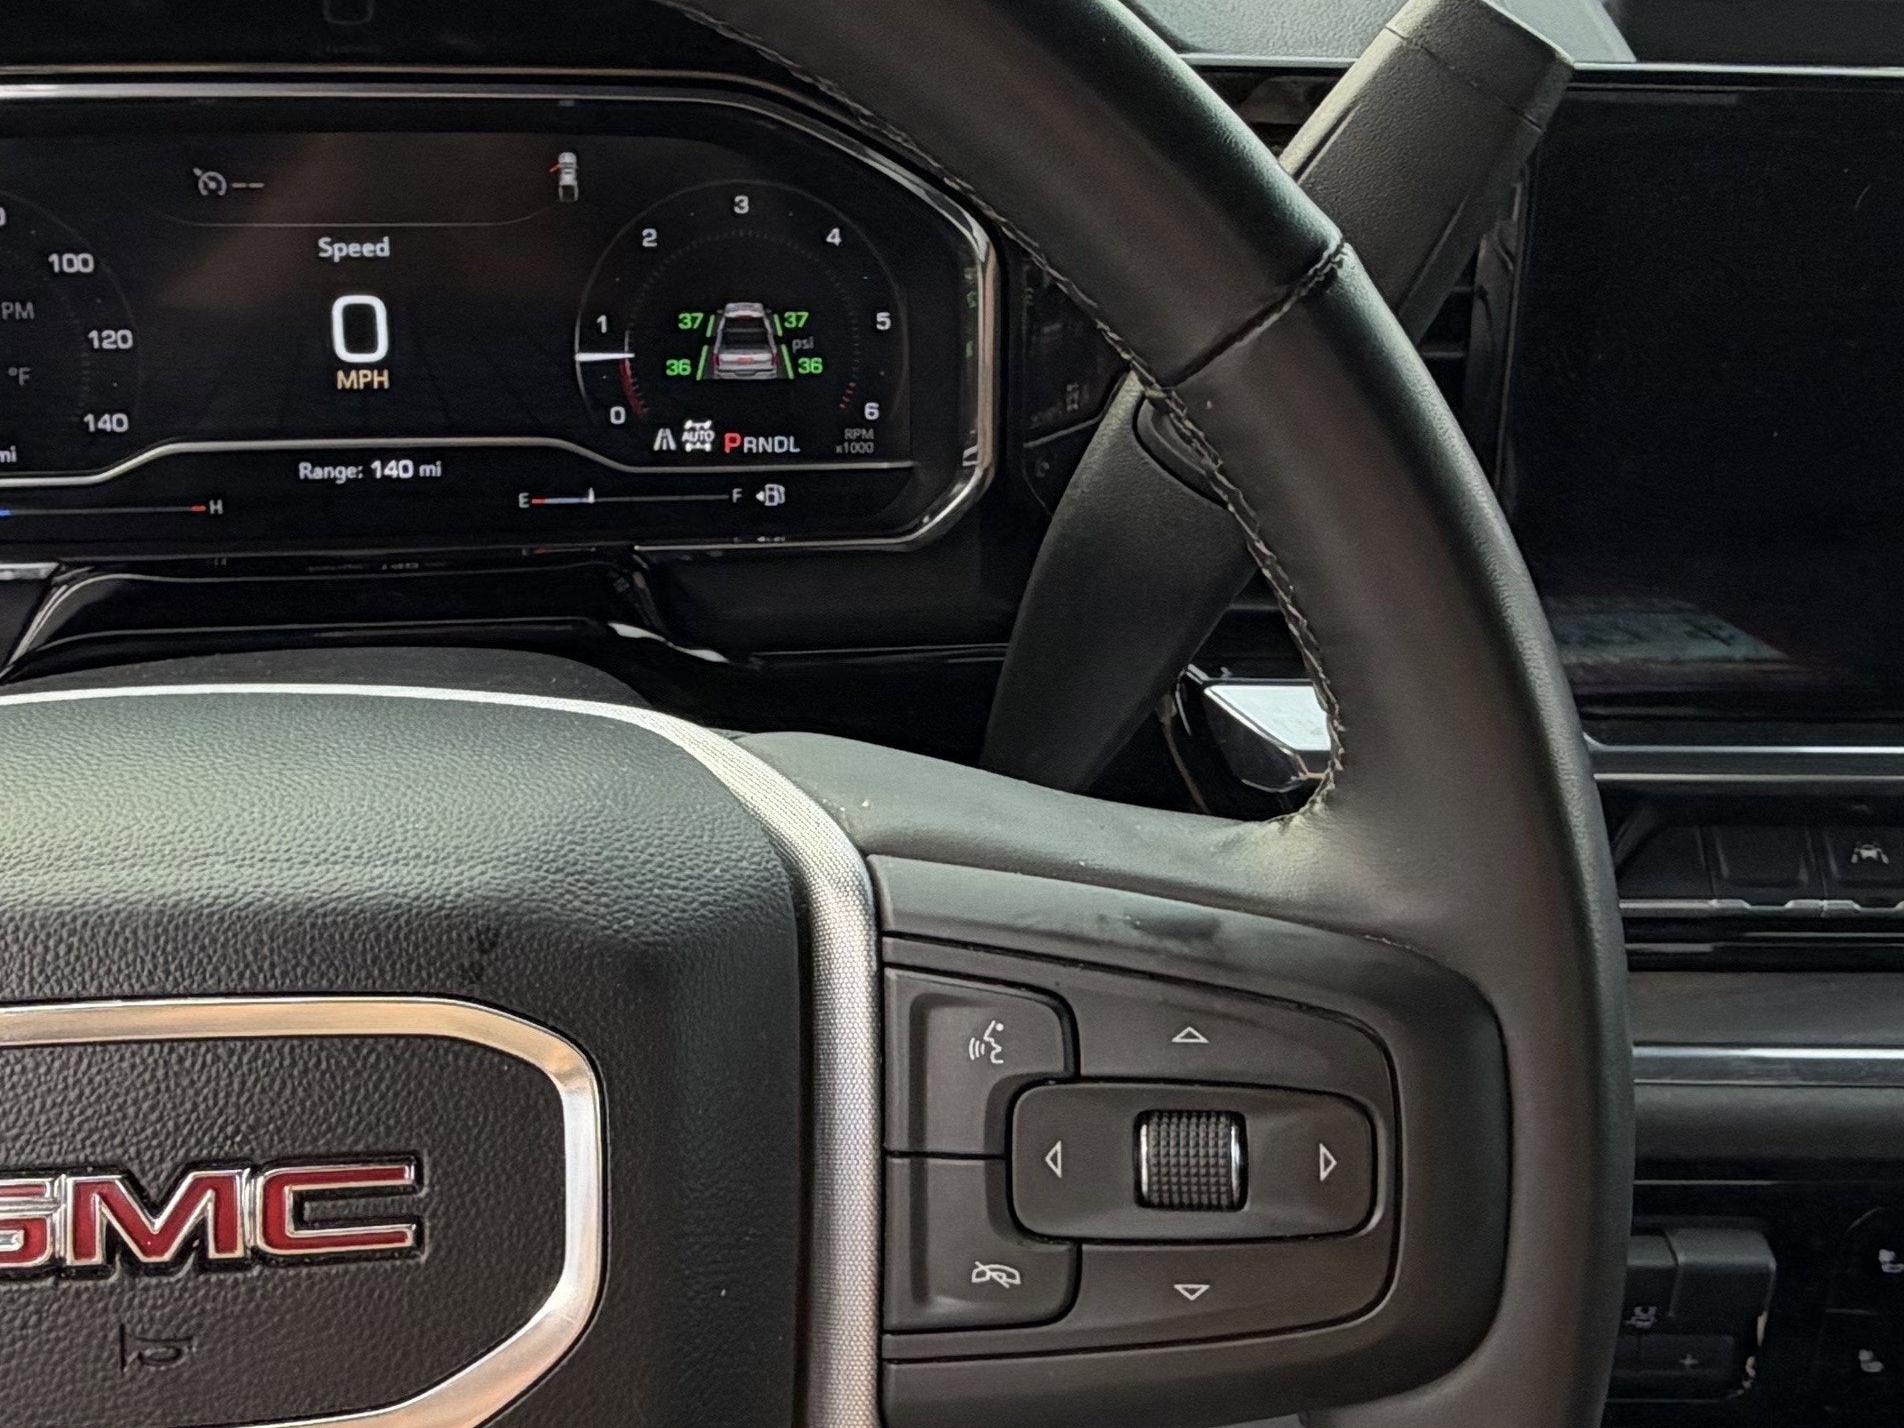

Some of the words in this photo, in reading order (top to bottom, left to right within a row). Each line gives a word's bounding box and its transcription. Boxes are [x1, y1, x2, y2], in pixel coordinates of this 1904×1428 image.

[733, 195, 750, 214] 3
[641, 228, 659, 247] 2
[825, 227, 842, 246] 4
[317, 236, 391, 263] Speed
[48, 253, 95, 274] 100
[1, 302, 35, 320] PM
[783, 311, 810, 329] 37
[331, 294, 389, 364] 0
[595, 314, 608, 334] 1
[678, 312, 704, 330] 37
[875, 311, 892, 331] 5
[87, 329, 134, 350] 120
[791, 336, 815, 354] psi
[665, 359, 692, 376] 36
[797, 357, 824, 374] 36
[336, 368, 390, 390] MPH
[609, 405, 627, 425] 0
[863, 402, 880, 421] 6
[83, 413, 129, 433] 140
[681, 429, 716, 444] AUTO
[844, 427, 875, 440] RPM
[298, 461, 364, 484] Range:
[370, 459, 414, 479] 140
[419, 460, 442, 478] mi
[517, 492, 530, 509] E
[731, 488, 743, 503] F
[209, 499, 224, 516] H
